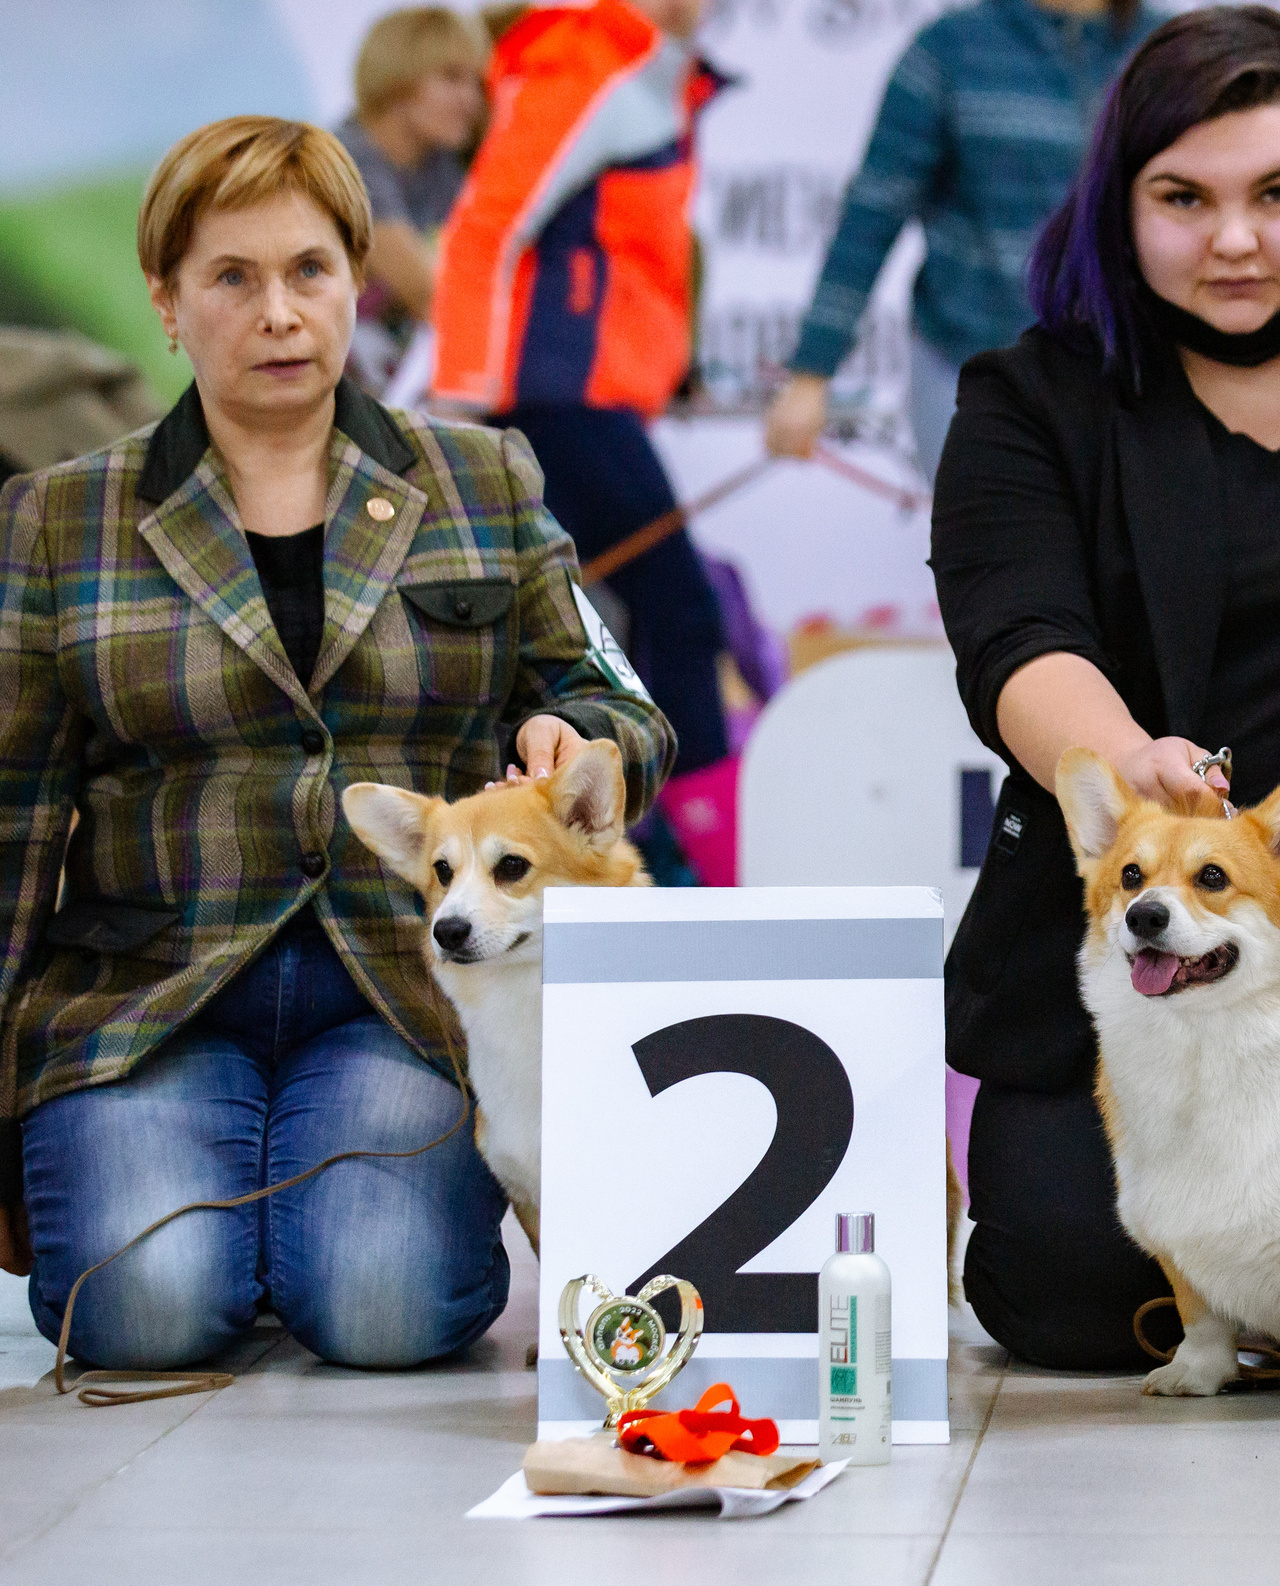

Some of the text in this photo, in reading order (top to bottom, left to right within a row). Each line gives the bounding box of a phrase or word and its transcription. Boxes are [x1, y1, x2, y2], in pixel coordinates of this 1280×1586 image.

[625, 1013, 855, 1334] 2
[619, 1306, 643, 1316] 2022
[830, 1294, 849, 1364] ELITE
